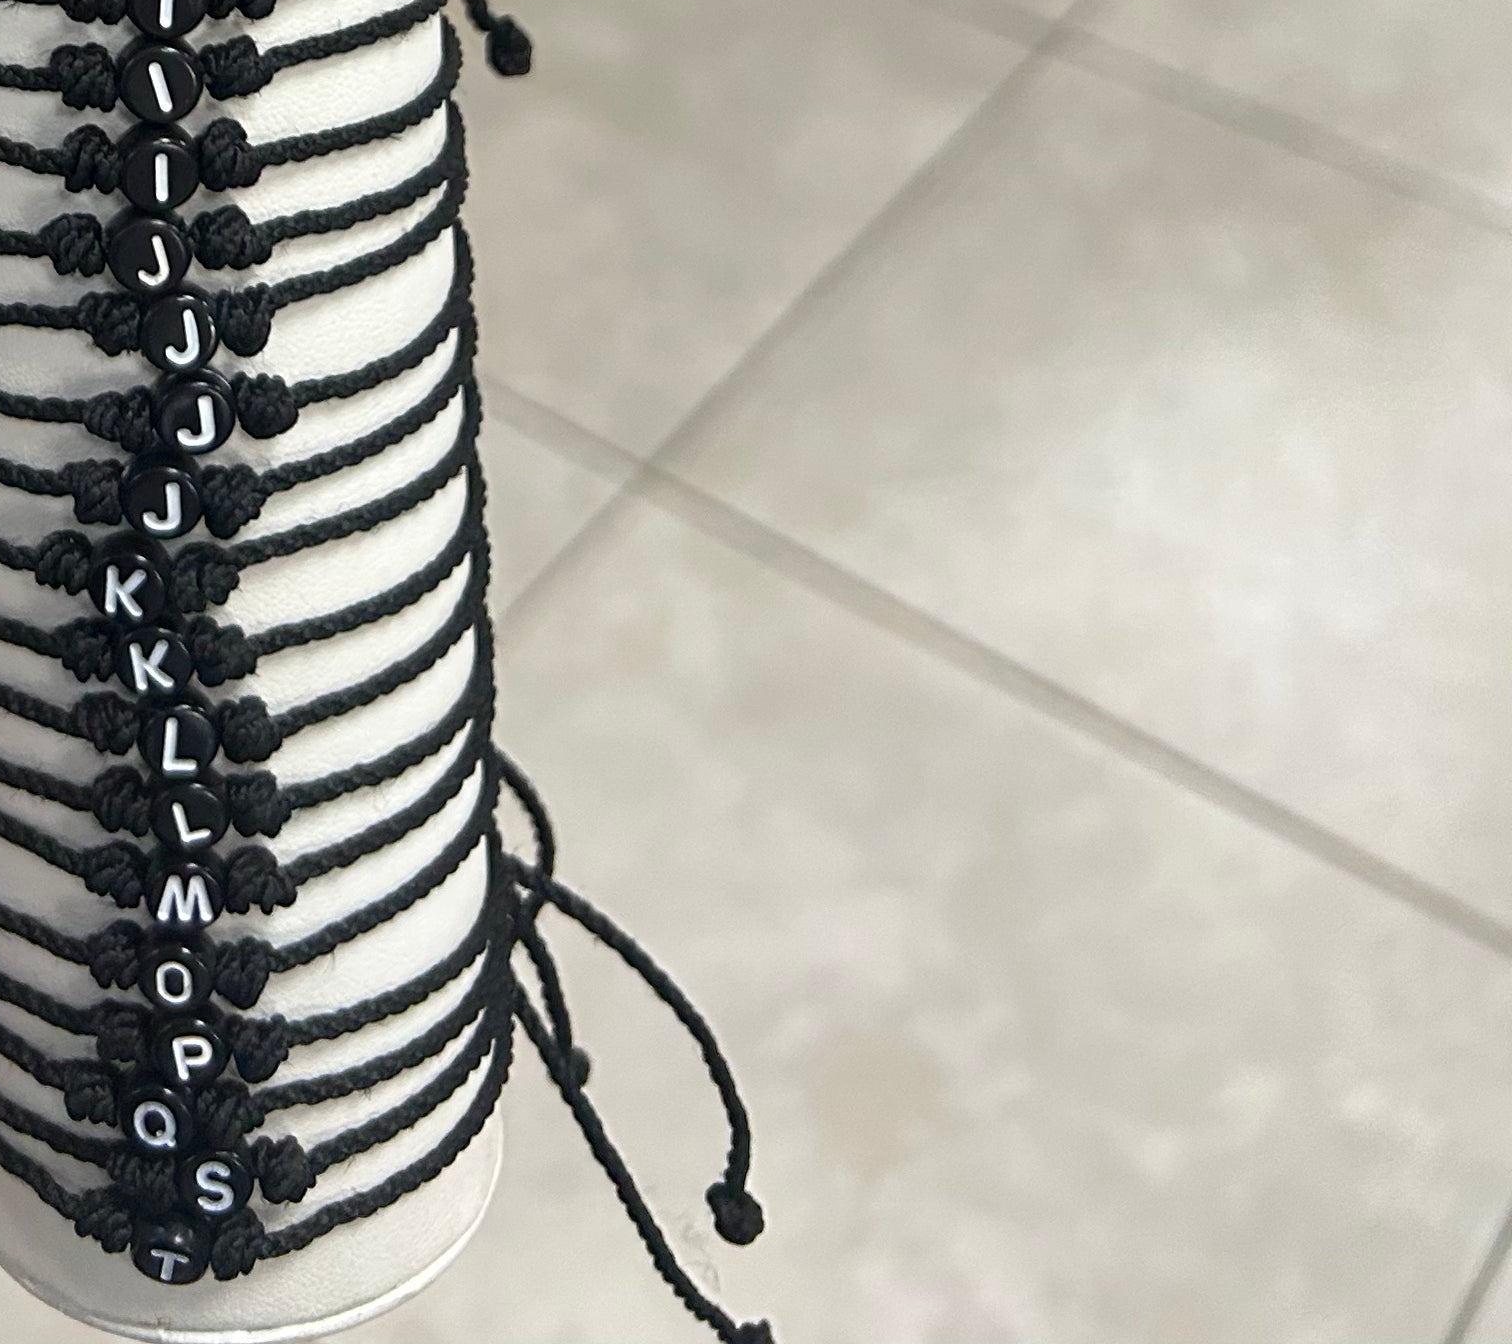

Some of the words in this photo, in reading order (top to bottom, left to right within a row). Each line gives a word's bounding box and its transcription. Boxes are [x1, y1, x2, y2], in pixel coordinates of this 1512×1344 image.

[148, 62, 172, 112] I
[155, 154, 168, 202] I
[138, 235, 170, 286] J
[165, 309, 199, 365] J
[177, 395, 215, 446] J
[143, 482, 181, 531] J
[105, 565, 145, 617] K
[129, 640, 174, 690] K
[163, 718, 197, 773] L
[172, 802, 211, 843] L
[157, 875, 213, 921] M
[156, 961, 191, 1004] O
[172, 1035, 213, 1080] P
[133, 1101, 176, 1148] Q
[196, 1161, 234, 1210] S
[150, 1249, 192, 1281] T
